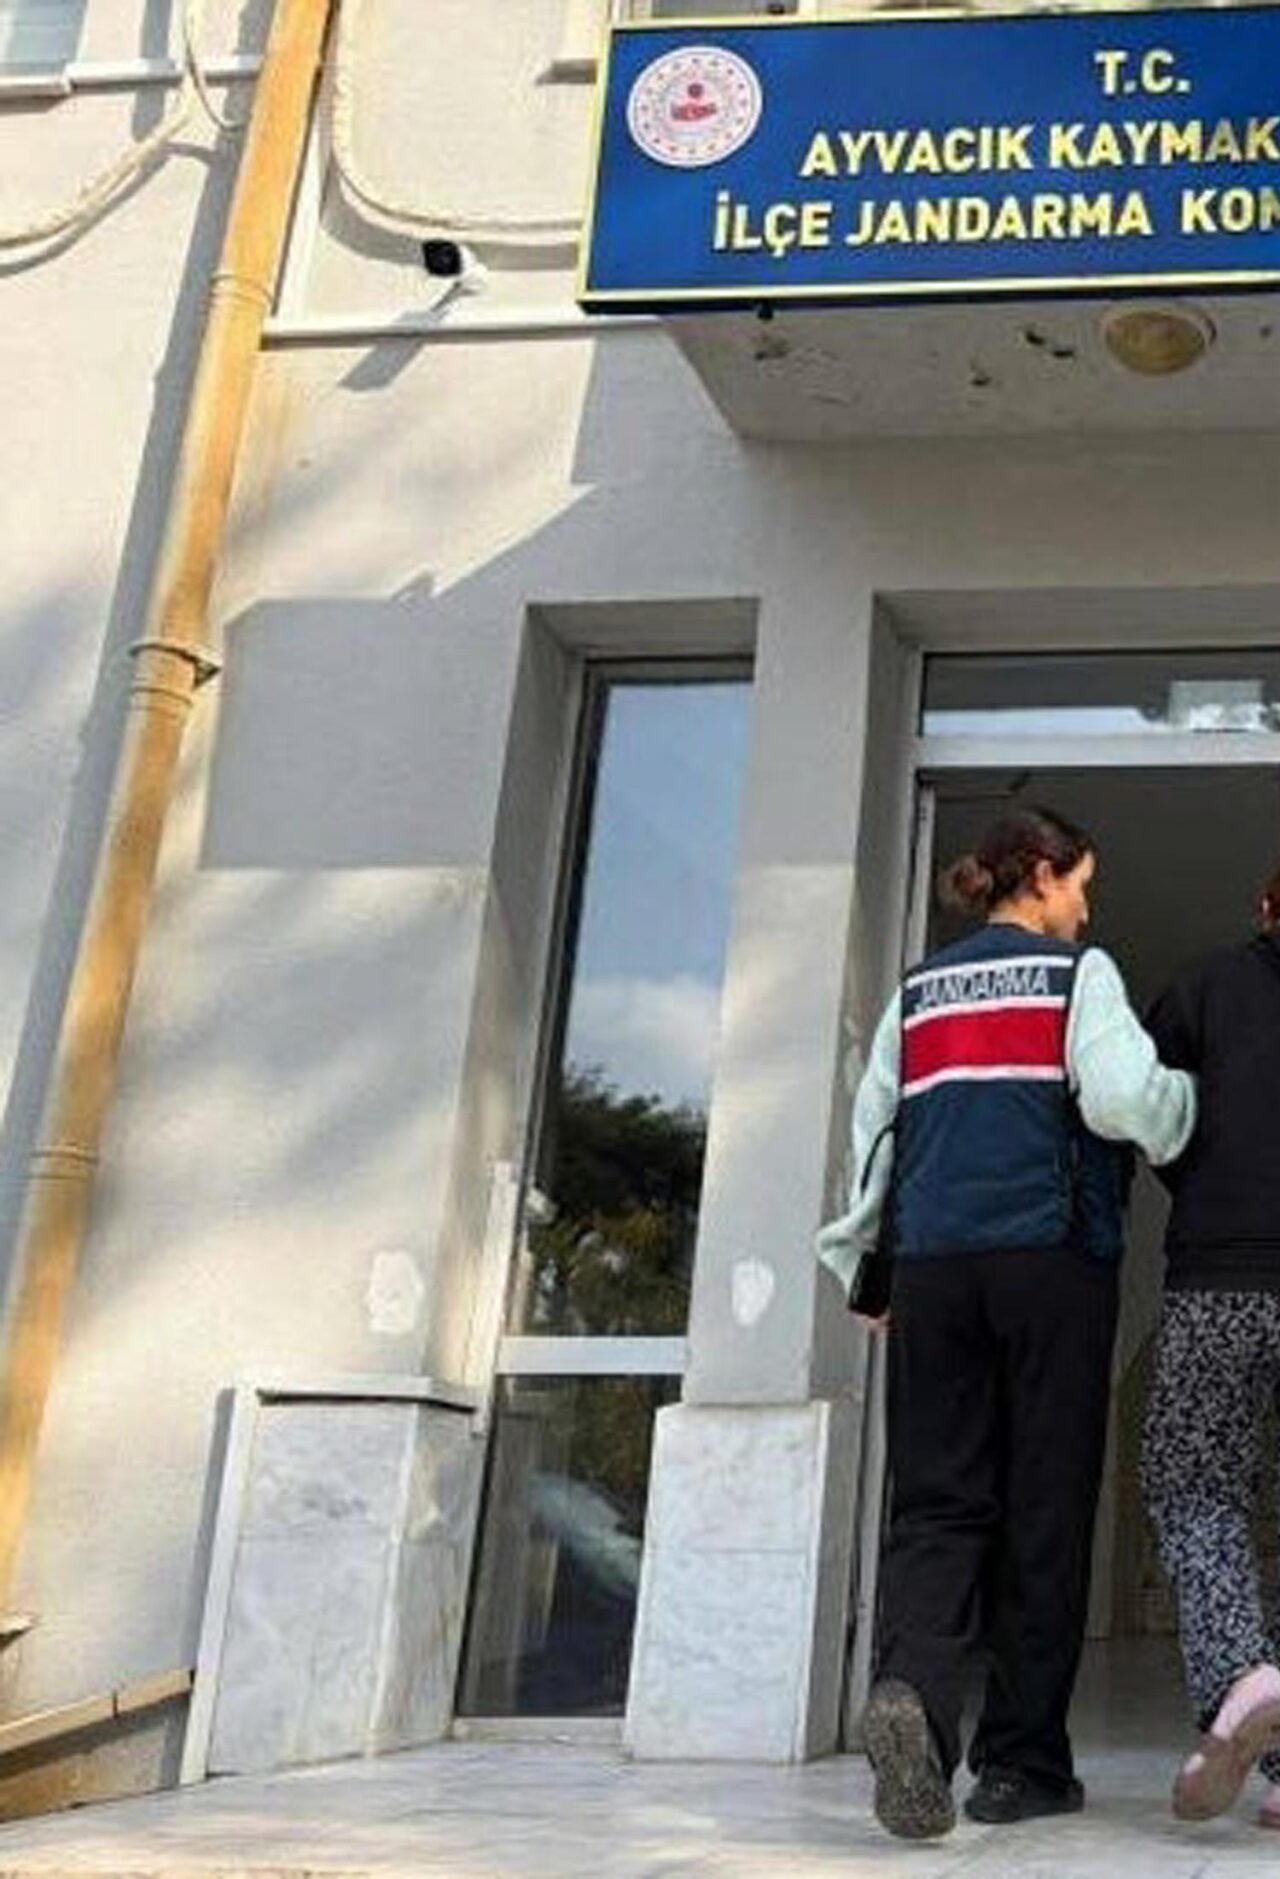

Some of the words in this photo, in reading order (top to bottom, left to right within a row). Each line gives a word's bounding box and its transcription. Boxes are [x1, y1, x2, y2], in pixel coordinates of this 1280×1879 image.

[1096, 50, 1191, 94] T.C.
[801, 126, 1032, 176] AYVACIK
[714, 191, 832, 256] İLÇE
[846, 193, 1152, 245] JANDARMA
[916, 966, 1048, 1012] JANDARMA
